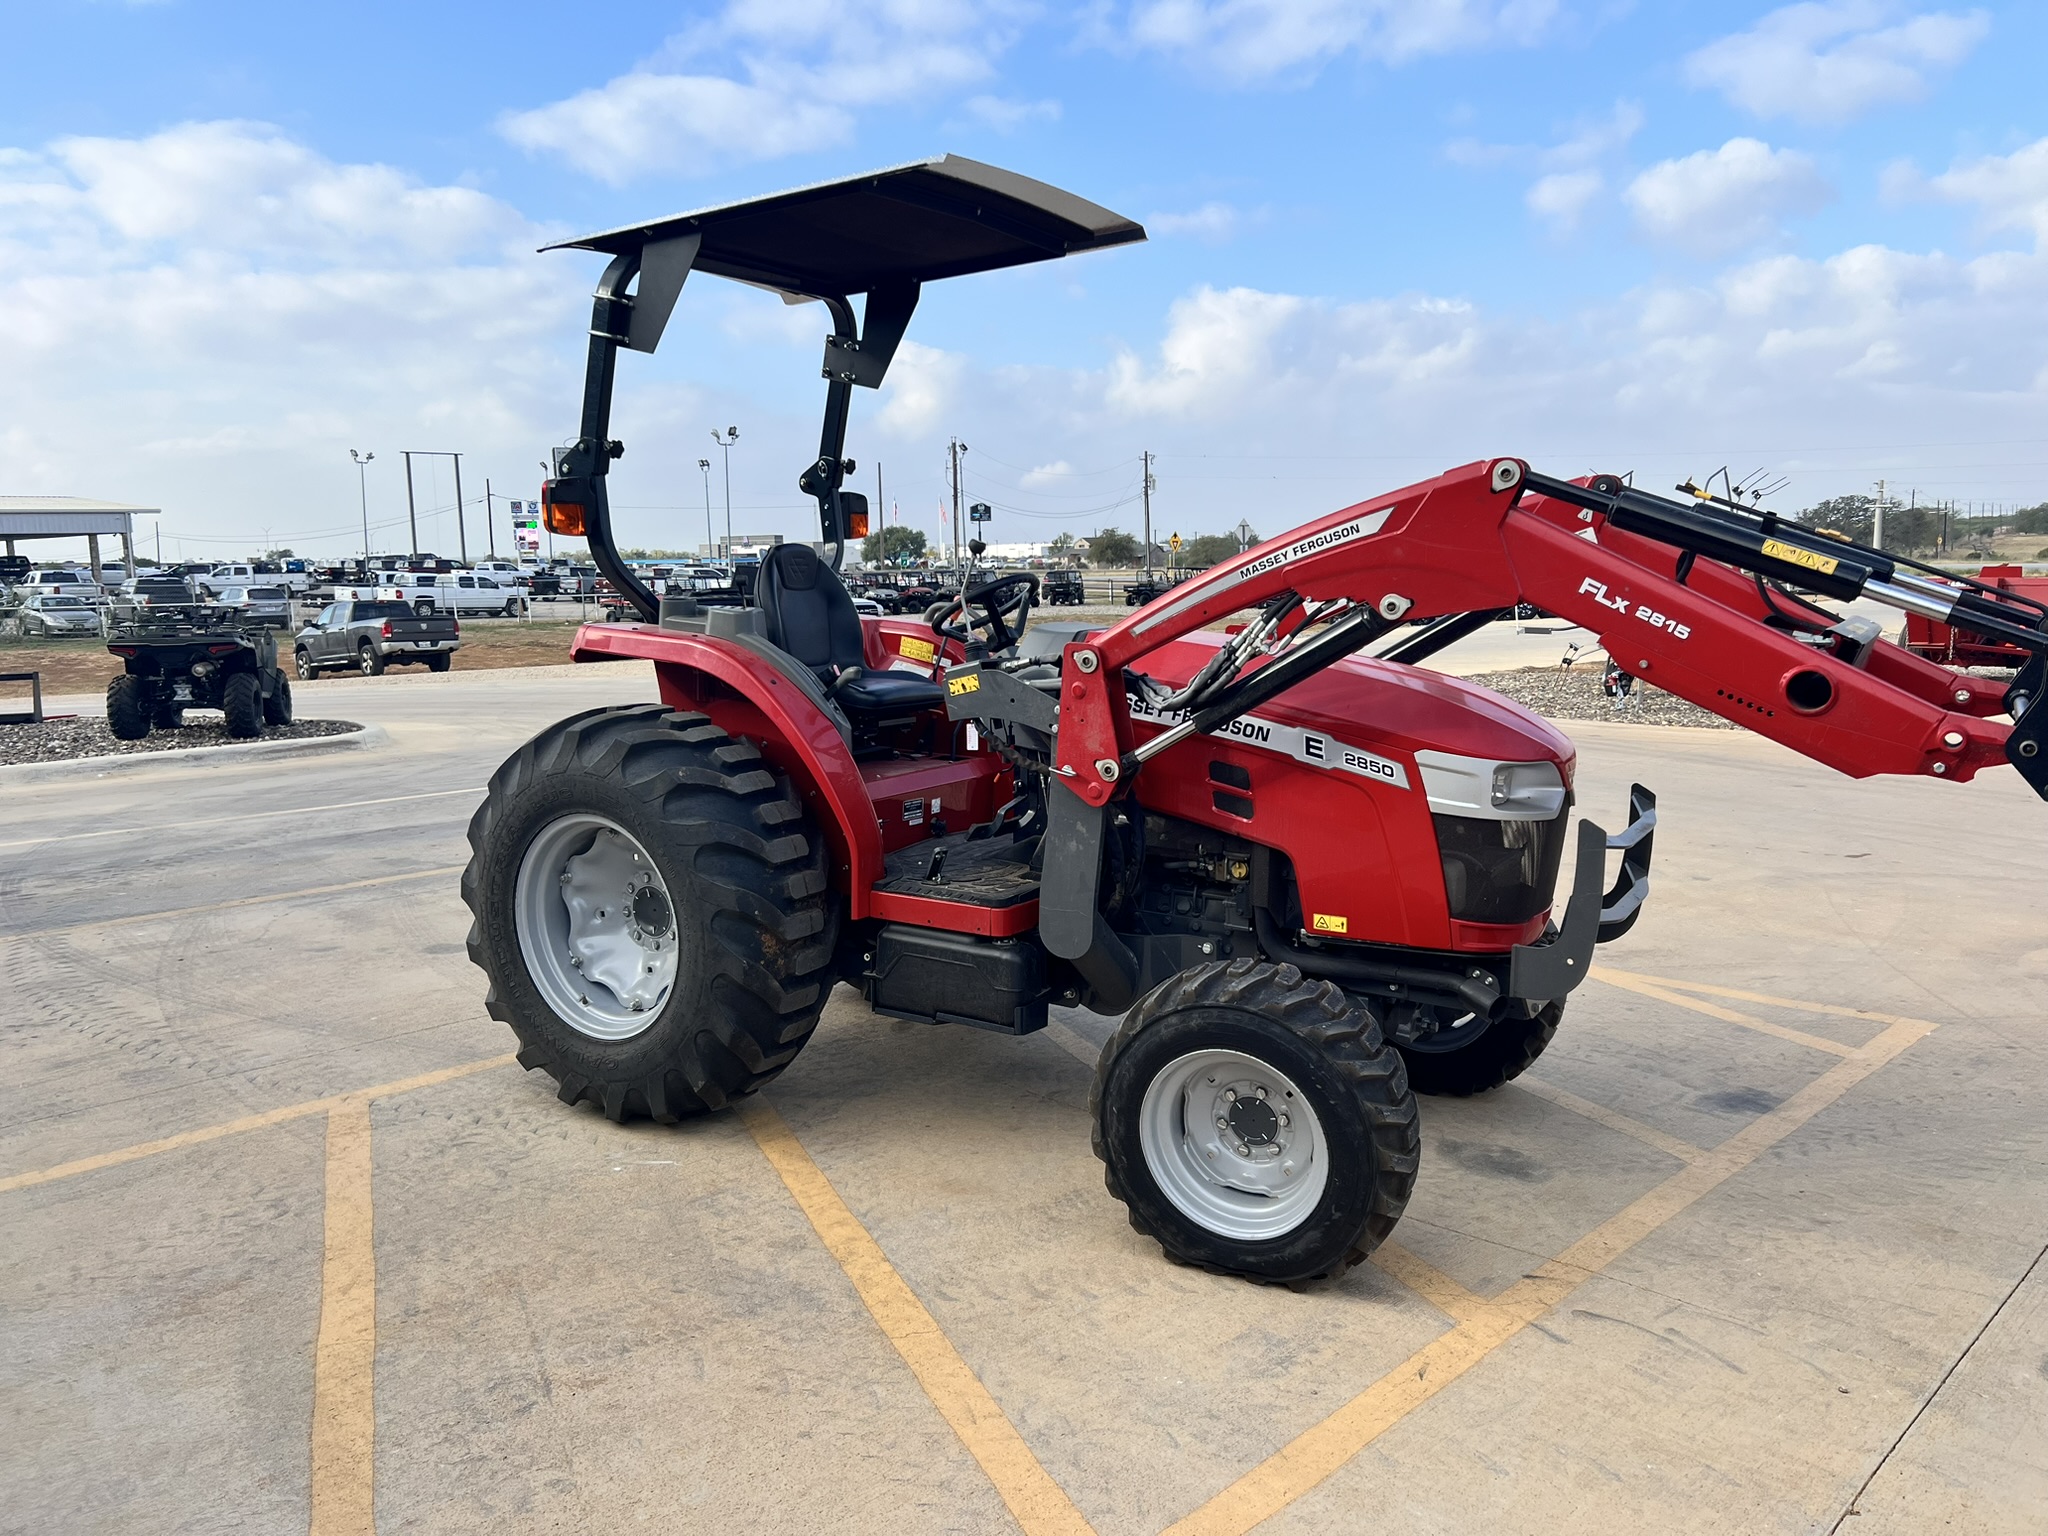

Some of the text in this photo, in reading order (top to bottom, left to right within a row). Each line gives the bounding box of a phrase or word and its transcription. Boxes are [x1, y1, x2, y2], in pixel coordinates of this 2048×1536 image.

[1240, 524, 1361, 579] MASSEY FERGUSON
[1635, 605, 1692, 640] 2815
[1304, 735, 1325, 761] E
[1343, 751, 1395, 779] 2850
